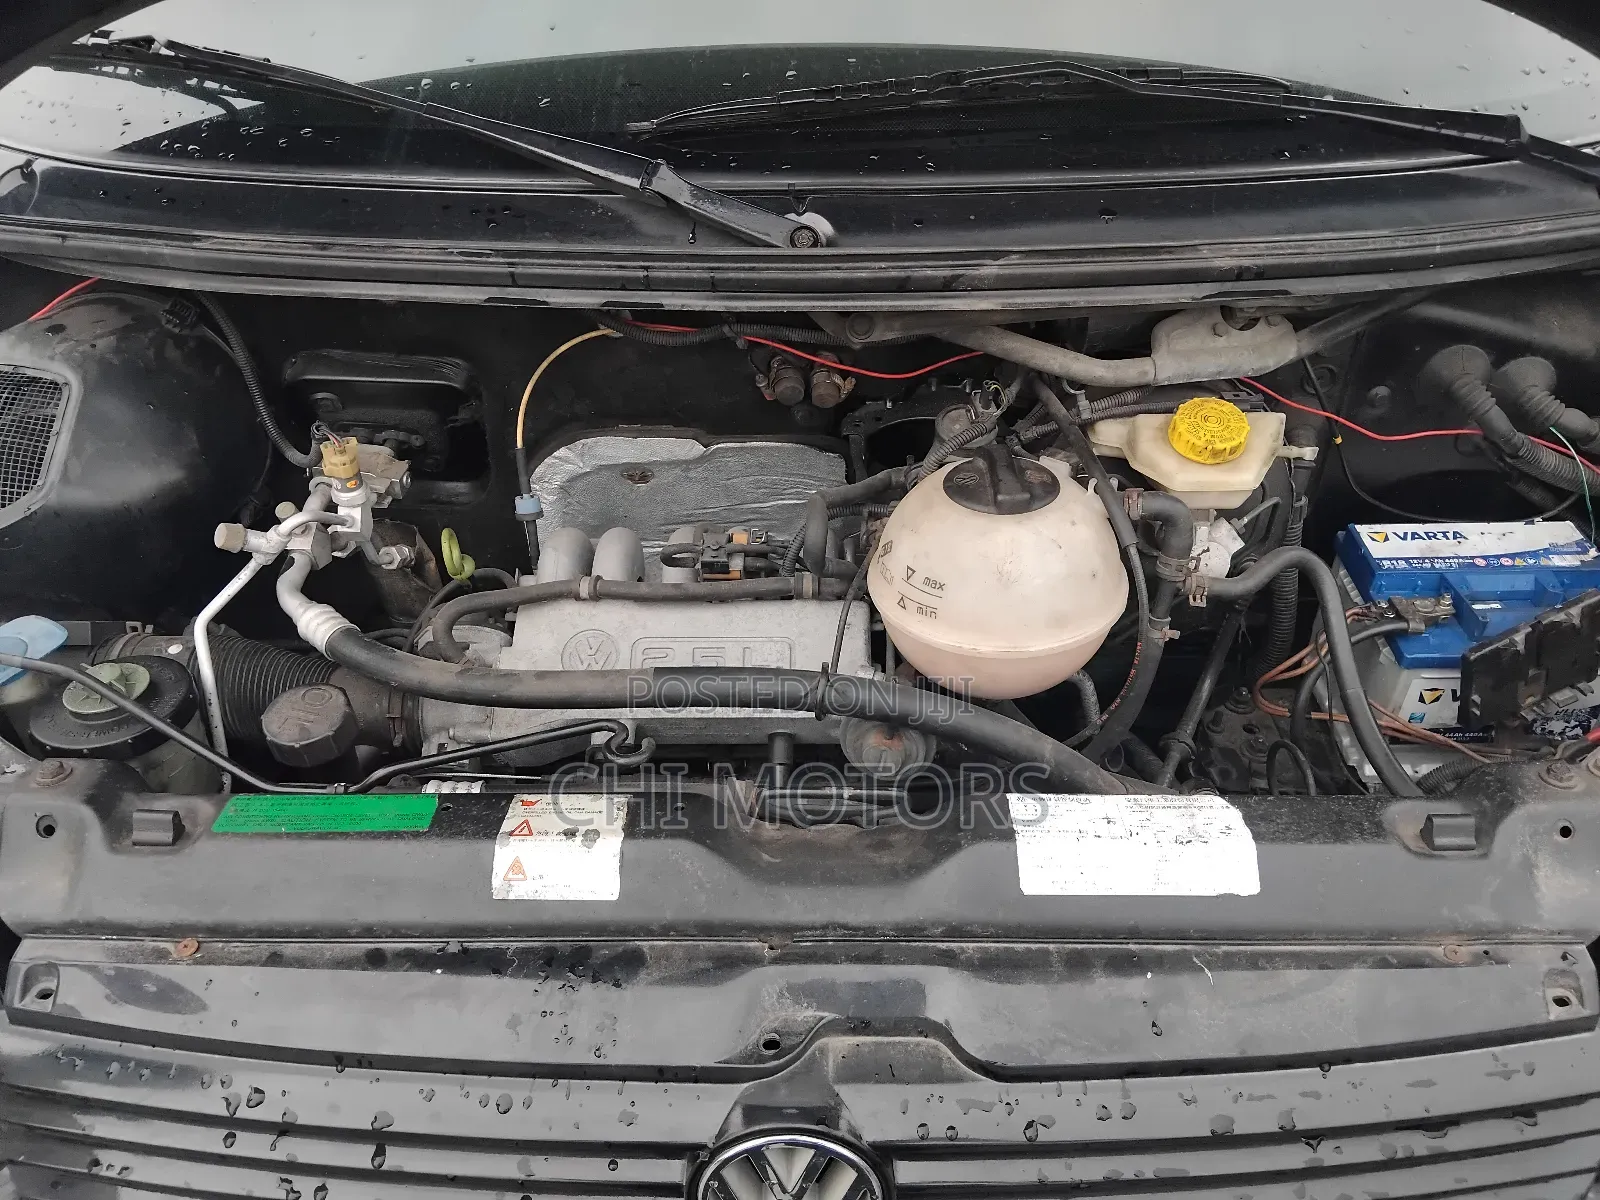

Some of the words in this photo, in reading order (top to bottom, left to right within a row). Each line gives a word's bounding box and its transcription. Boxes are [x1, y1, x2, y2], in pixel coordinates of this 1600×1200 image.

[1393, 531, 1470, 542] VARTA
[922, 576, 946, 591] max
[916, 606, 937, 619] min
